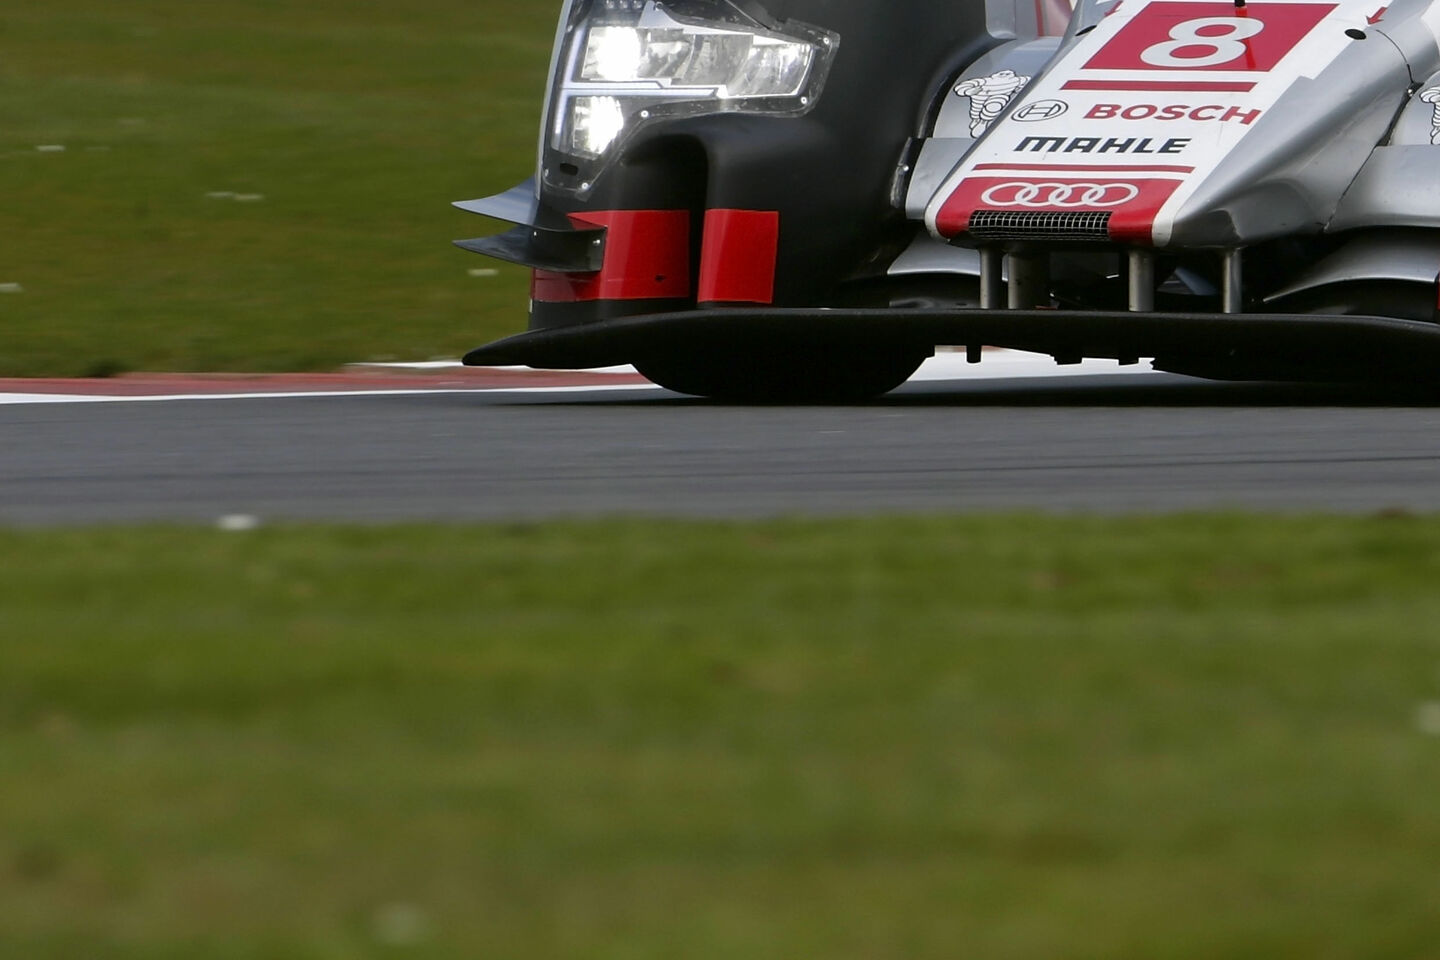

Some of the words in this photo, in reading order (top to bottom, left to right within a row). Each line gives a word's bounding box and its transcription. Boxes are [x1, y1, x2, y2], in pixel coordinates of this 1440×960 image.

[1140, 16, 1265, 68] 8
[1083, 103, 1263, 126] BOSCH
[1013, 136, 1193, 154] MAHLE
